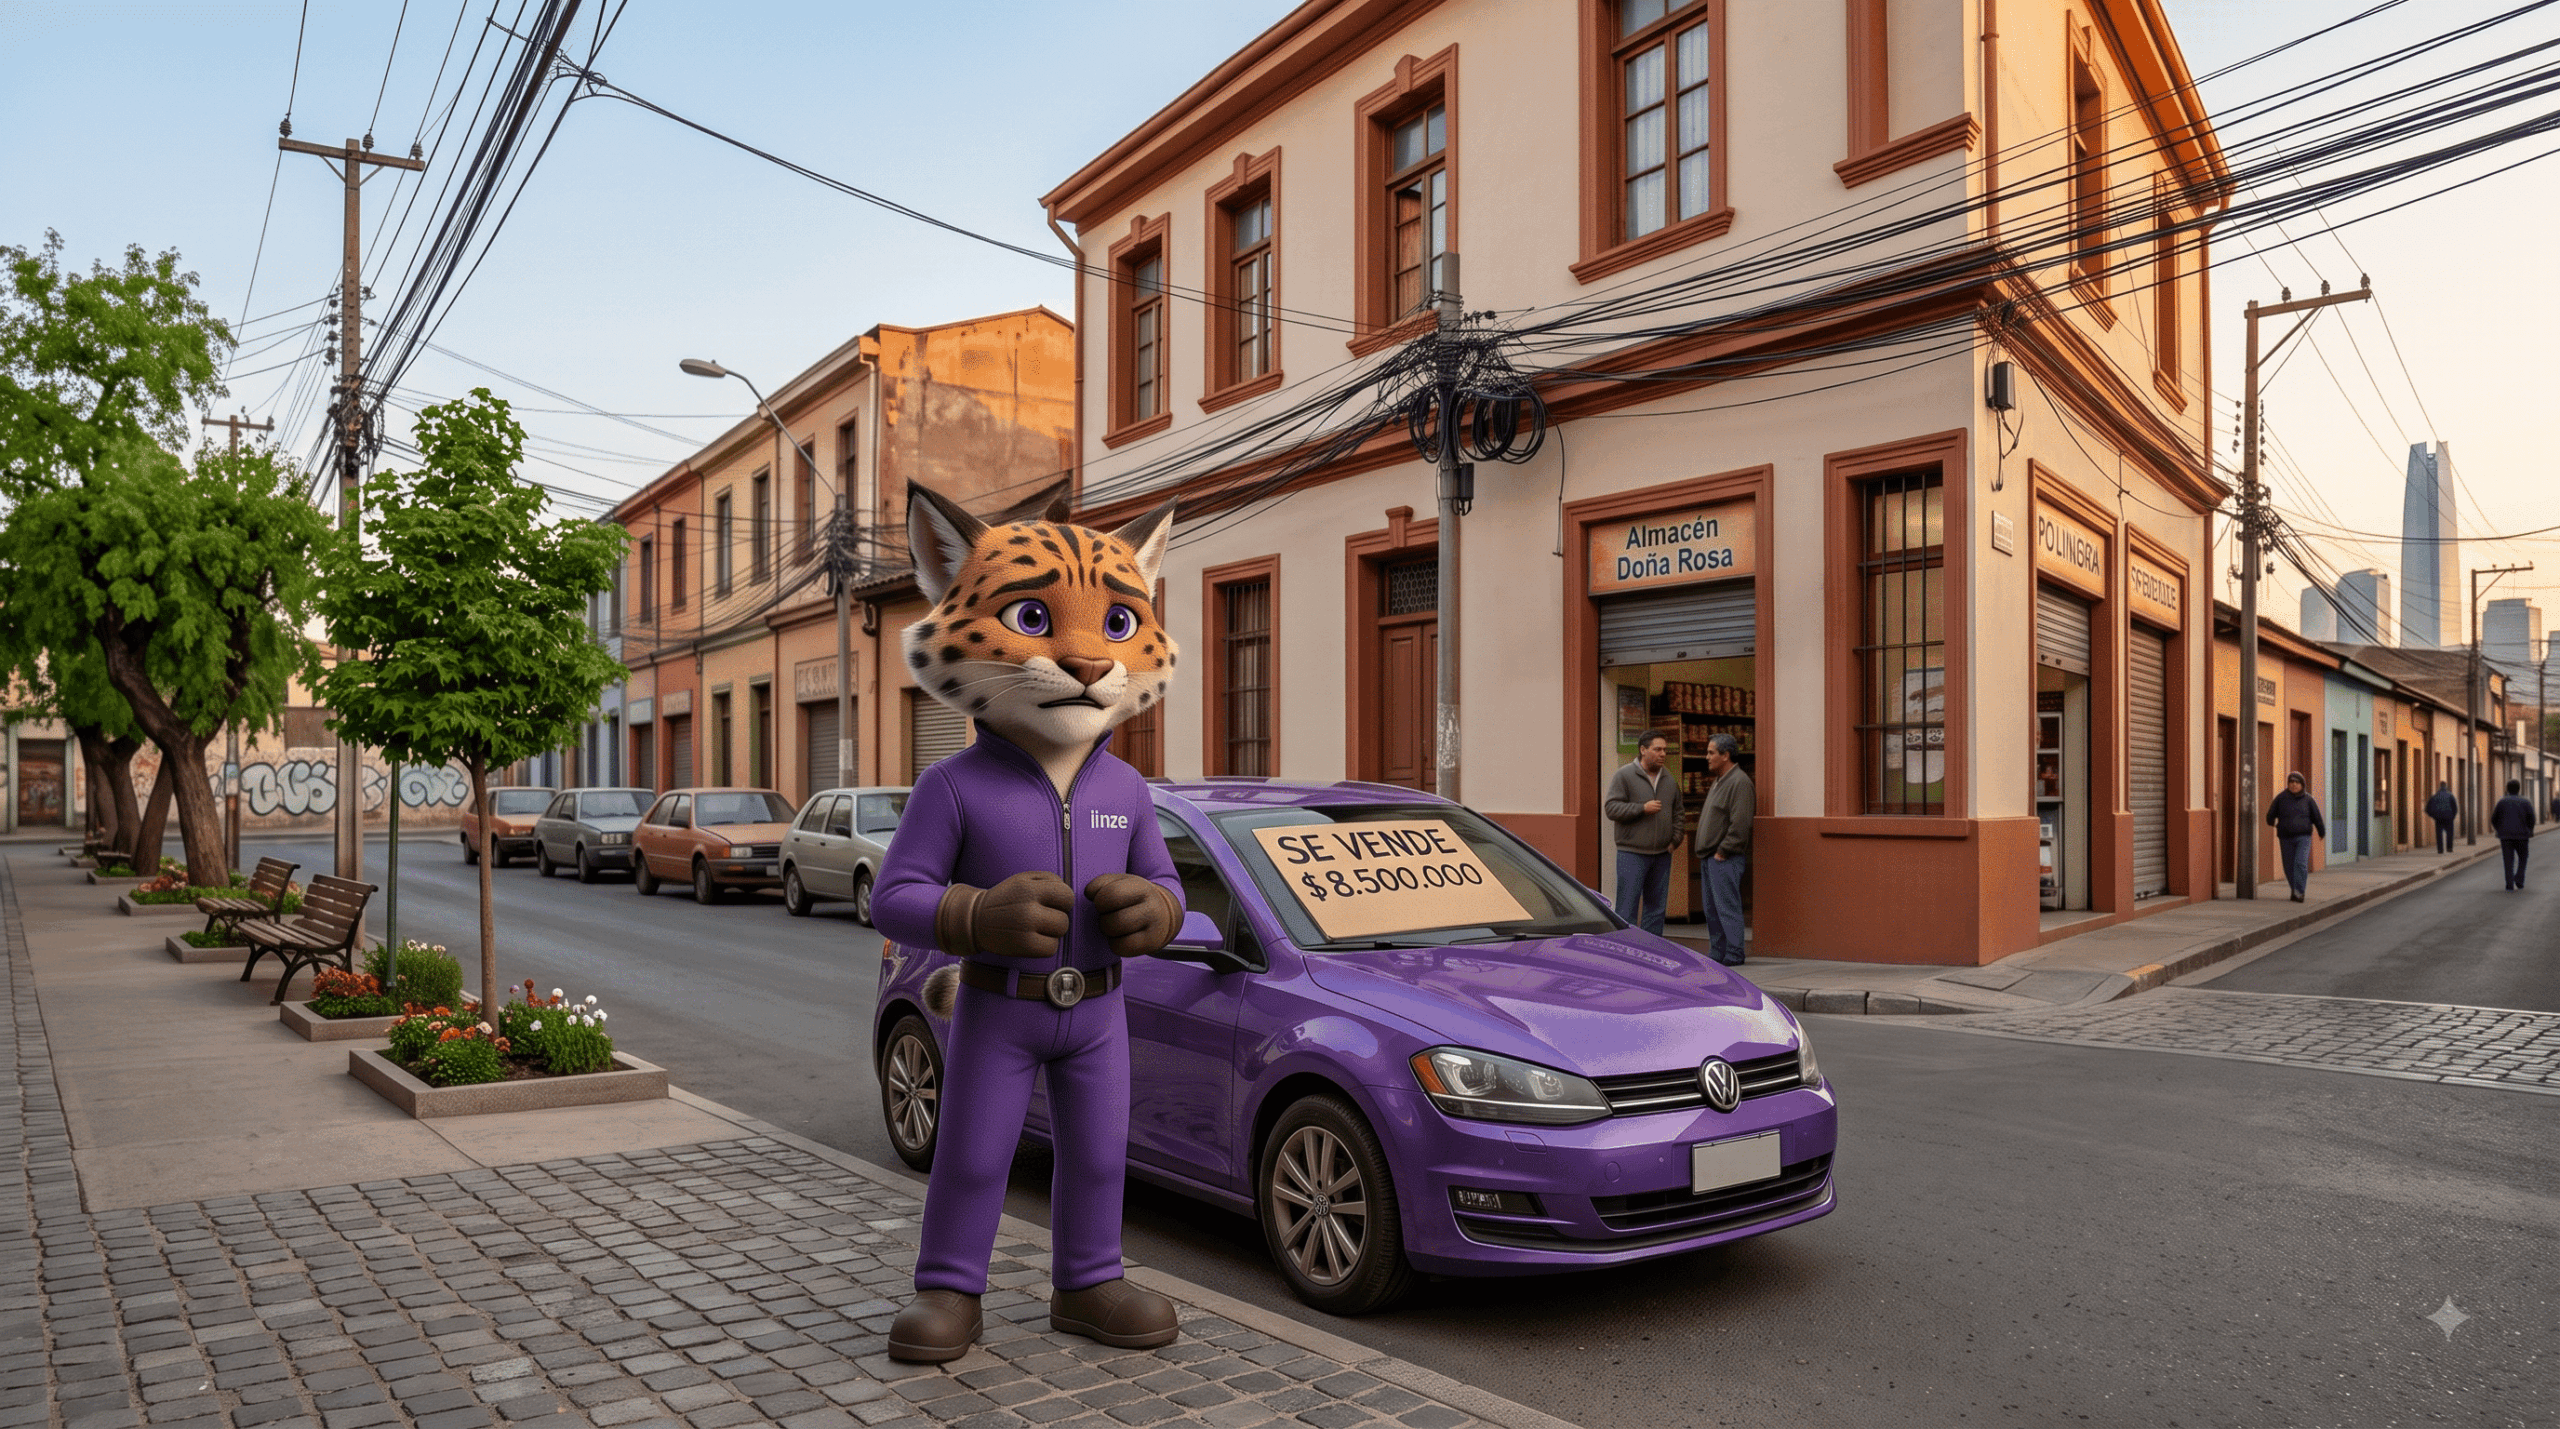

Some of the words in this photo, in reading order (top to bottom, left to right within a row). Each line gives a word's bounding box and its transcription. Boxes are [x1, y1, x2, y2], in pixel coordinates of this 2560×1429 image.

[1626, 515, 1718, 550] Almacén
[1617, 553, 1670, 581] Doña
[1677, 548, 1733, 573] Rosa
[1090, 809, 1128, 829] iinze
[1277, 834, 1335, 865] SE
[1332, 828, 1457, 860] VENDE
[1301, 862, 1483, 902] $8.500.000
